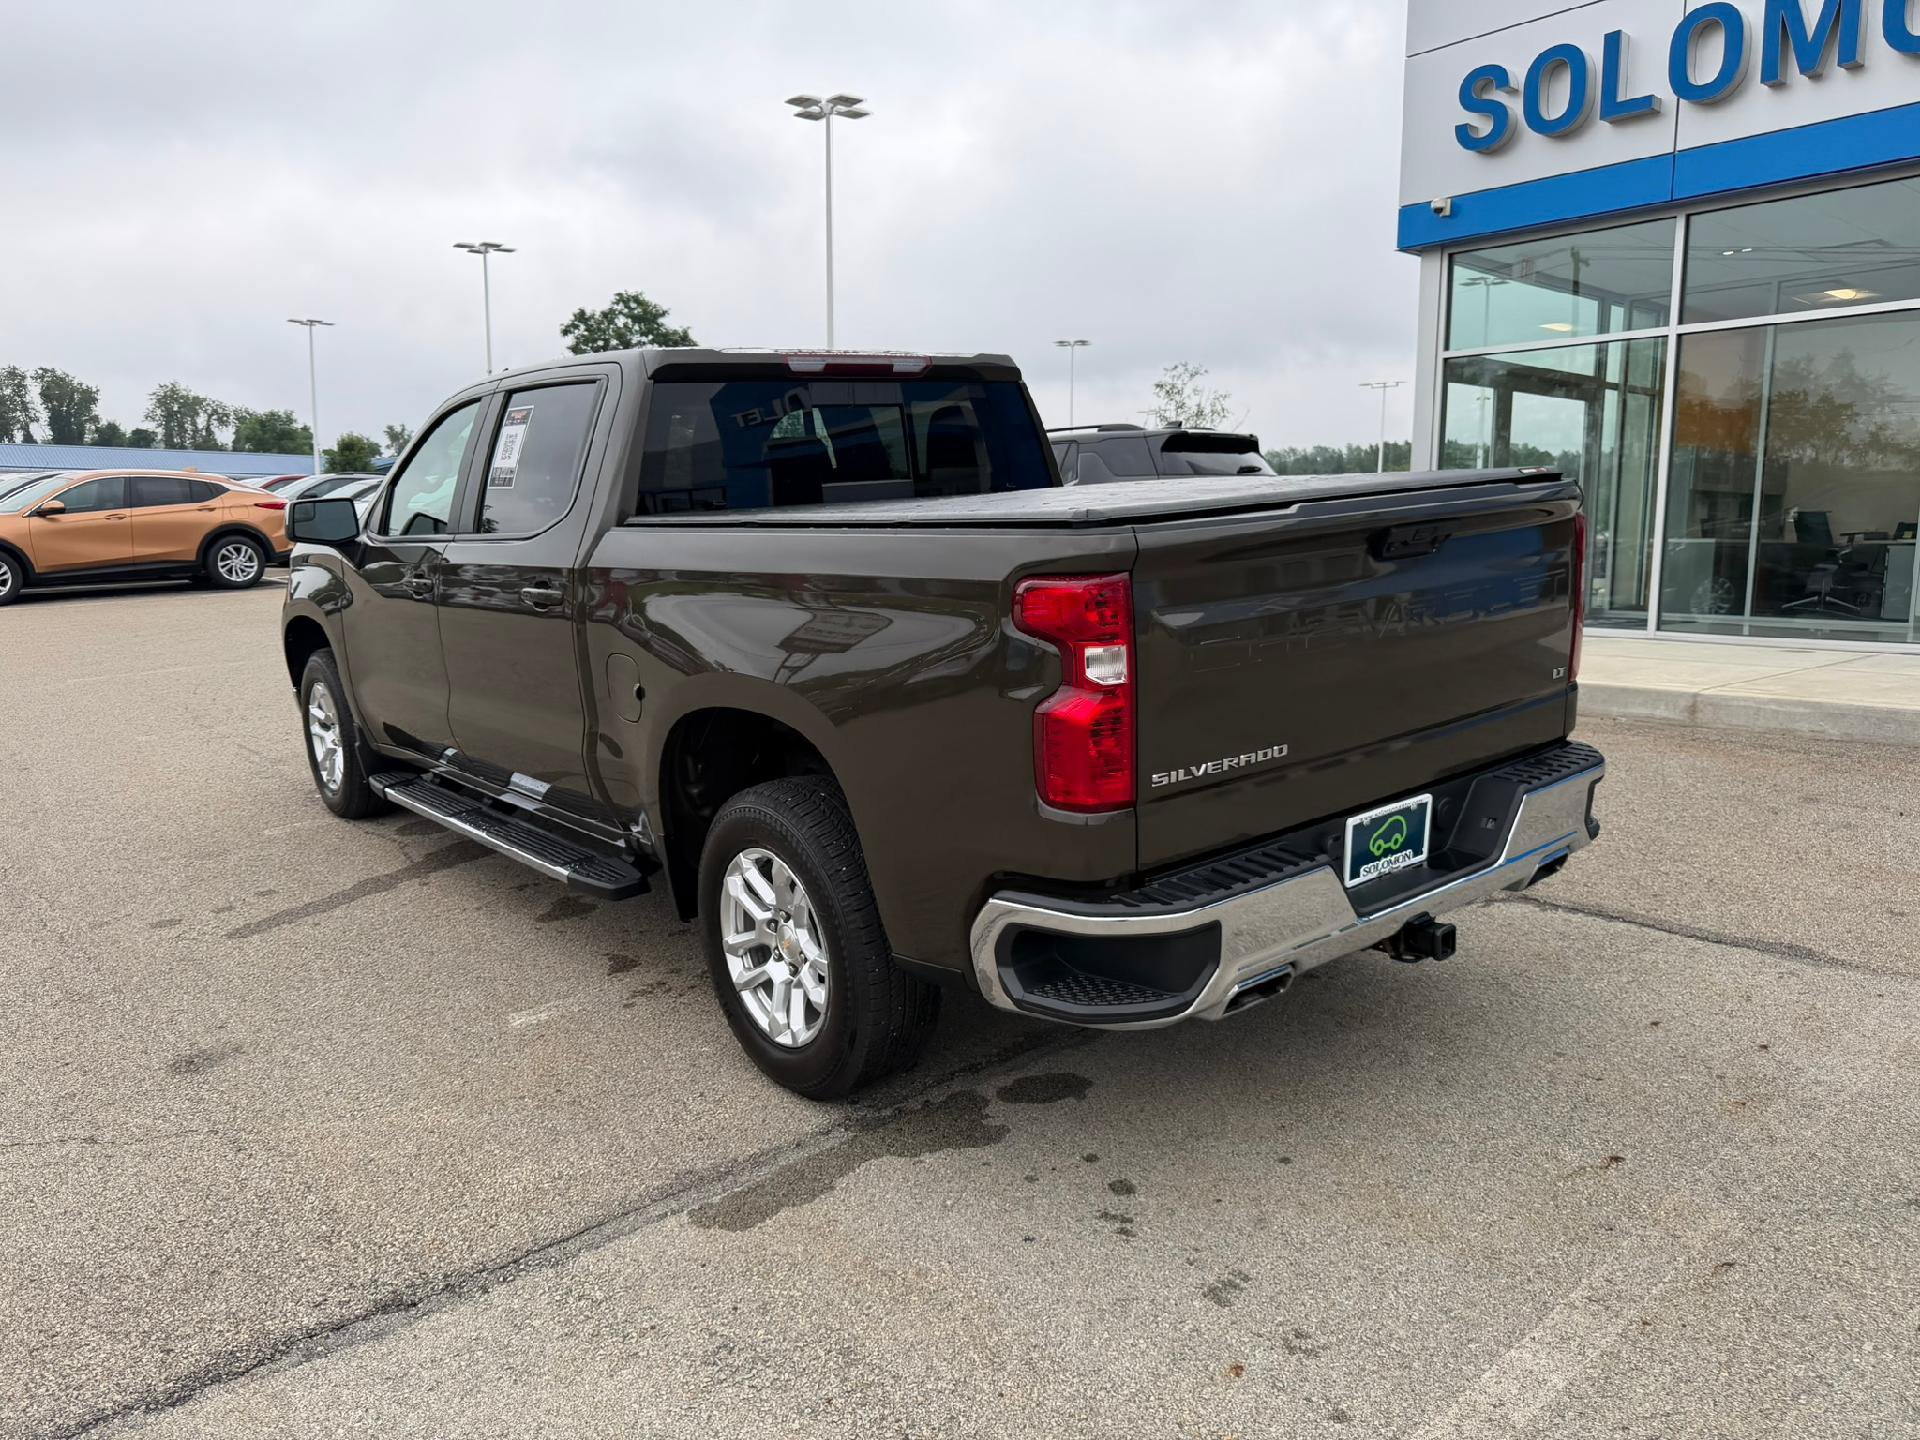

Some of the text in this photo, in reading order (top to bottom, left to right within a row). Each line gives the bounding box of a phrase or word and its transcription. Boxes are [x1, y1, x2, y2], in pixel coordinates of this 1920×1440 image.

[1552, 667, 1567, 680] LT
[1151, 744, 1288, 787] SILVERADO
[1362, 851, 1412, 877] SOLOMON
